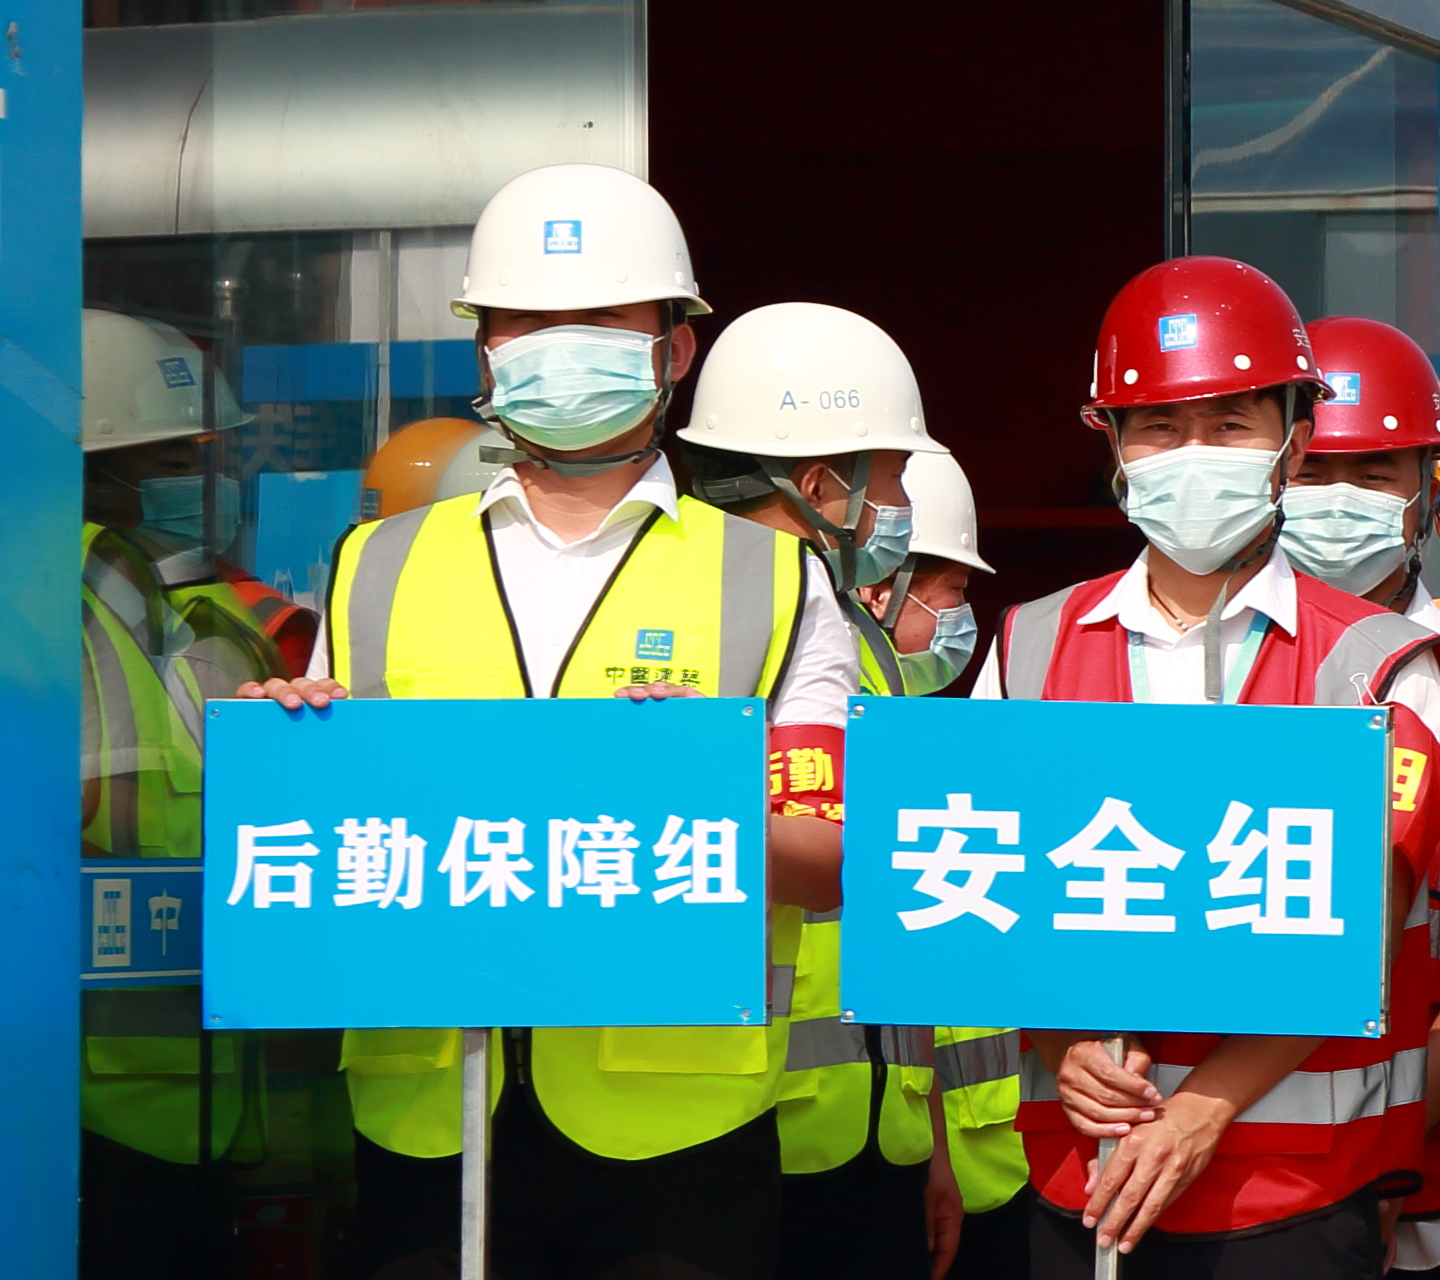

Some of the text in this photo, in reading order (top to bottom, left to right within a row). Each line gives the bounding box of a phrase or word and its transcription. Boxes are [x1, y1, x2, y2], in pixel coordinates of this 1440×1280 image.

[226, 814, 748, 910] 后勤保障组
[891, 792, 1345, 935] 安全组
